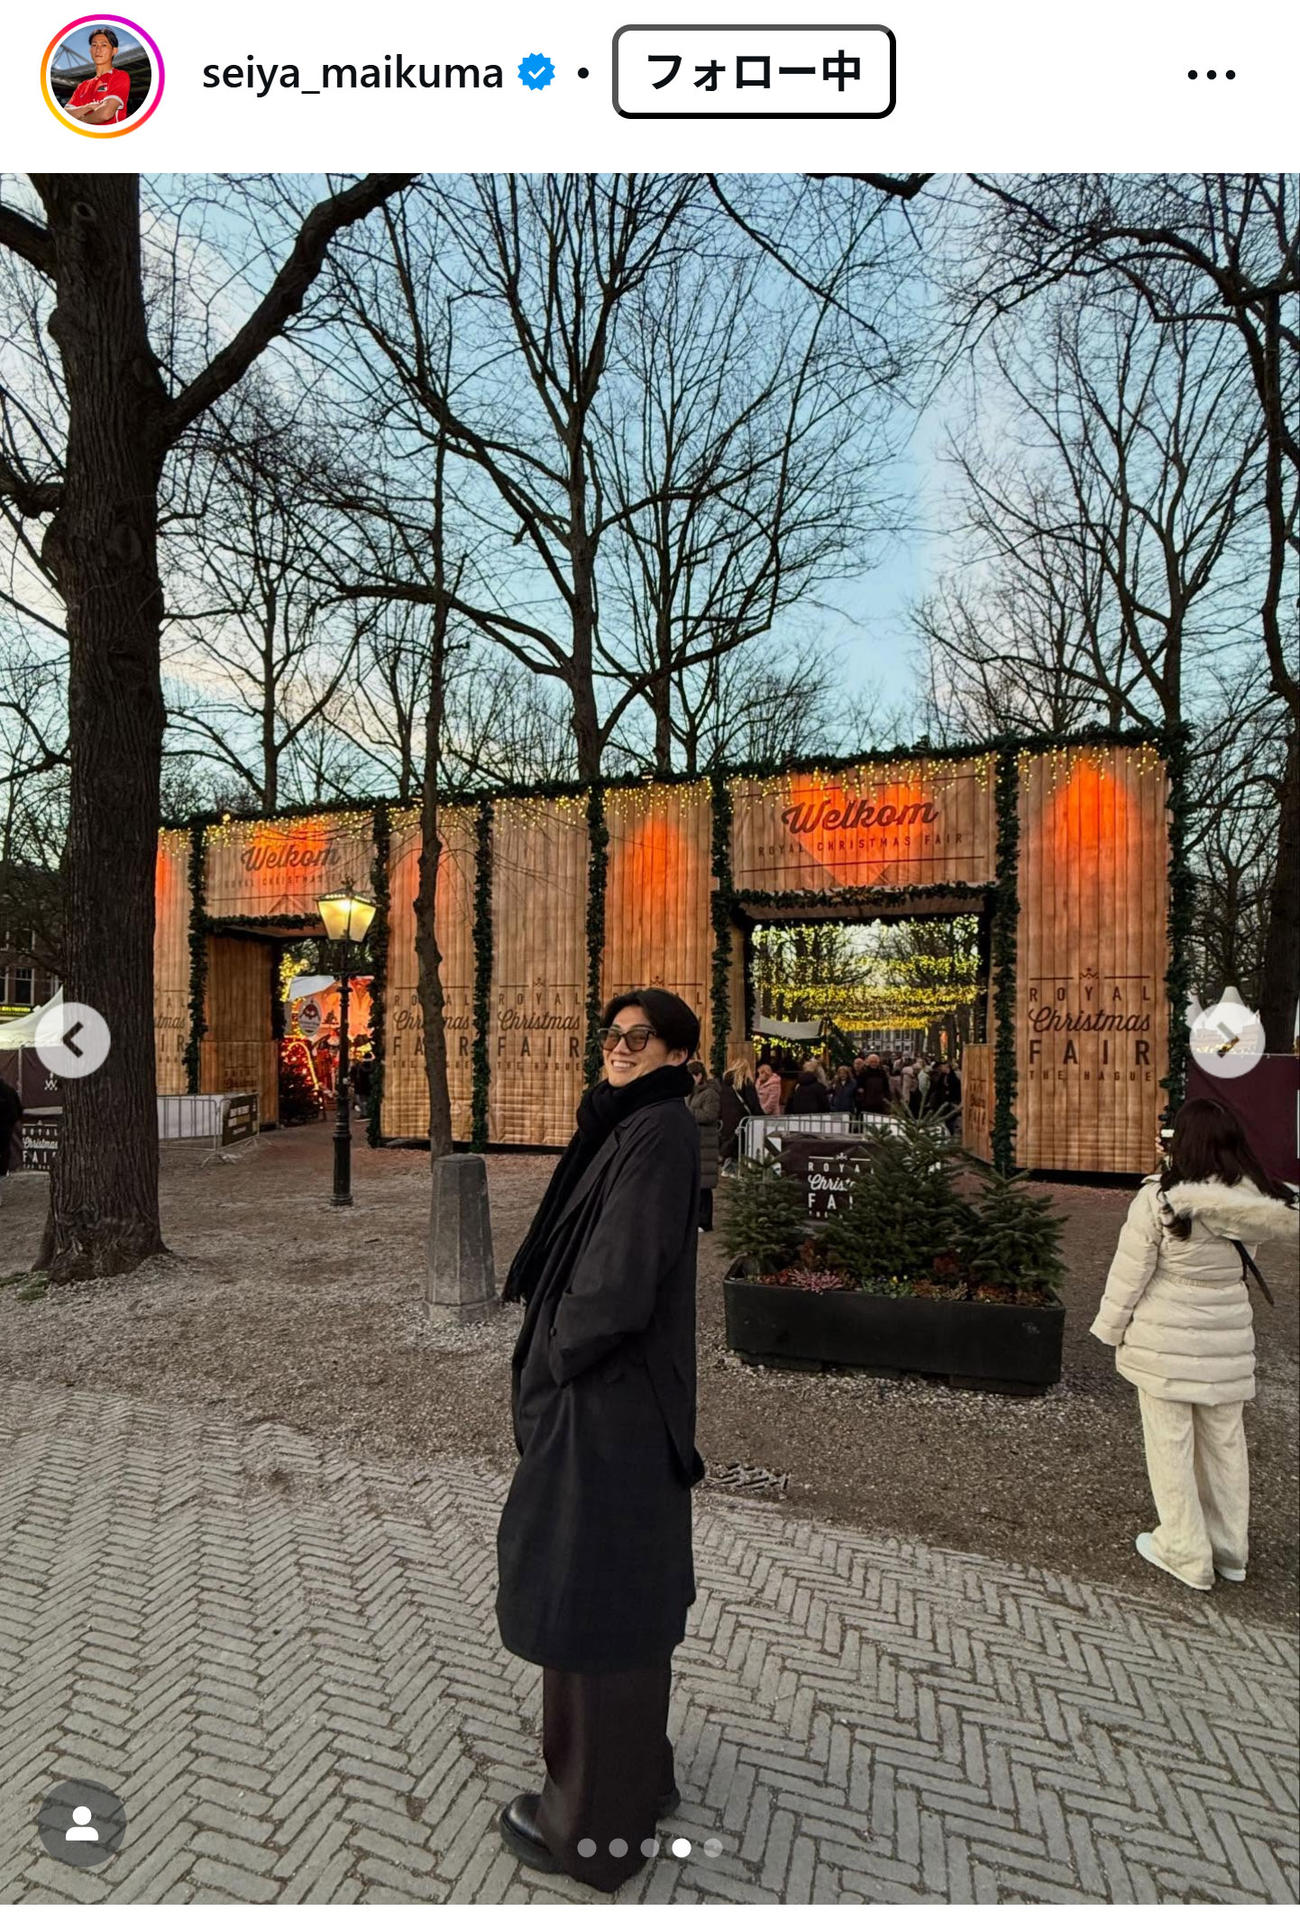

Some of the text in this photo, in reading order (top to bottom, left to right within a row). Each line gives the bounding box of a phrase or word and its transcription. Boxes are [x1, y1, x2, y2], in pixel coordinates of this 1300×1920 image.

[781, 799, 938, 834] Welkom
[758, 832, 963, 857] ROYAL CHRISTMAS FAIR
[241, 843, 342, 872] Welkom
[394, 994, 470, 1006] ROAL
[498, 992, 581, 1005] ROYAL
[1029, 985, 1151, 1002] ROYAL
[393, 1009, 470, 1031] Chrmas
[497, 1009, 581, 1031] Christmas
[1028, 1006, 1151, 1033] Christmas
[393, 1036, 469, 1057] FAR
[497, 1036, 580, 1058] FAIR
[1029, 1039, 1151, 1066] FAIR
[1030, 1070, 1152, 1082] THE HAGUE
